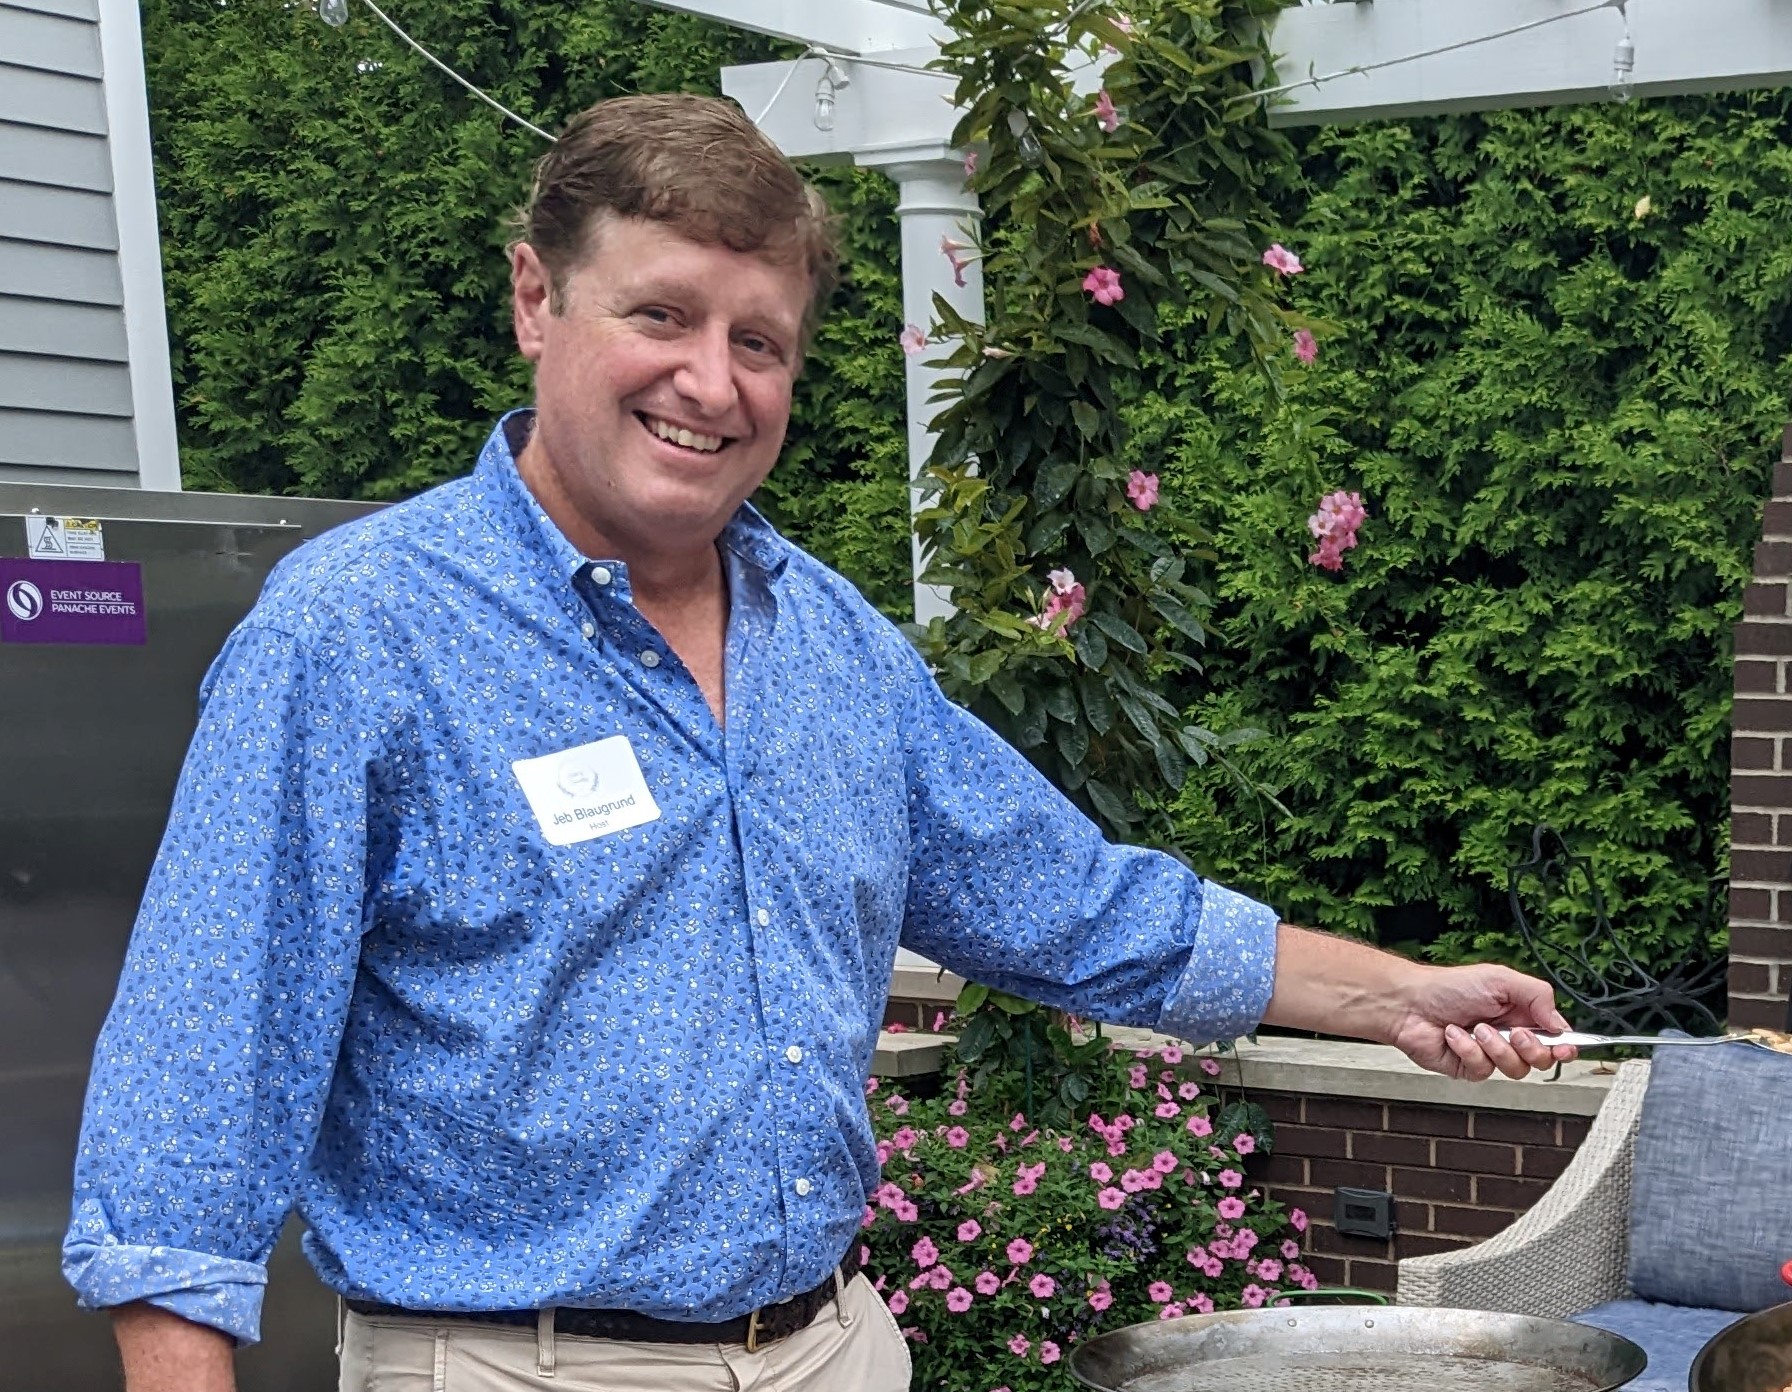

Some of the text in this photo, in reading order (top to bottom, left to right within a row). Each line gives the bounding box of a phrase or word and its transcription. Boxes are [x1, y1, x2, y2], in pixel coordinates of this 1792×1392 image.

[51, 590, 122, 601] EVENT SOURCE
[52, 603, 136, 615] PANACHE EVENTS
[553, 794, 636, 825] Jeb Blaugrund
